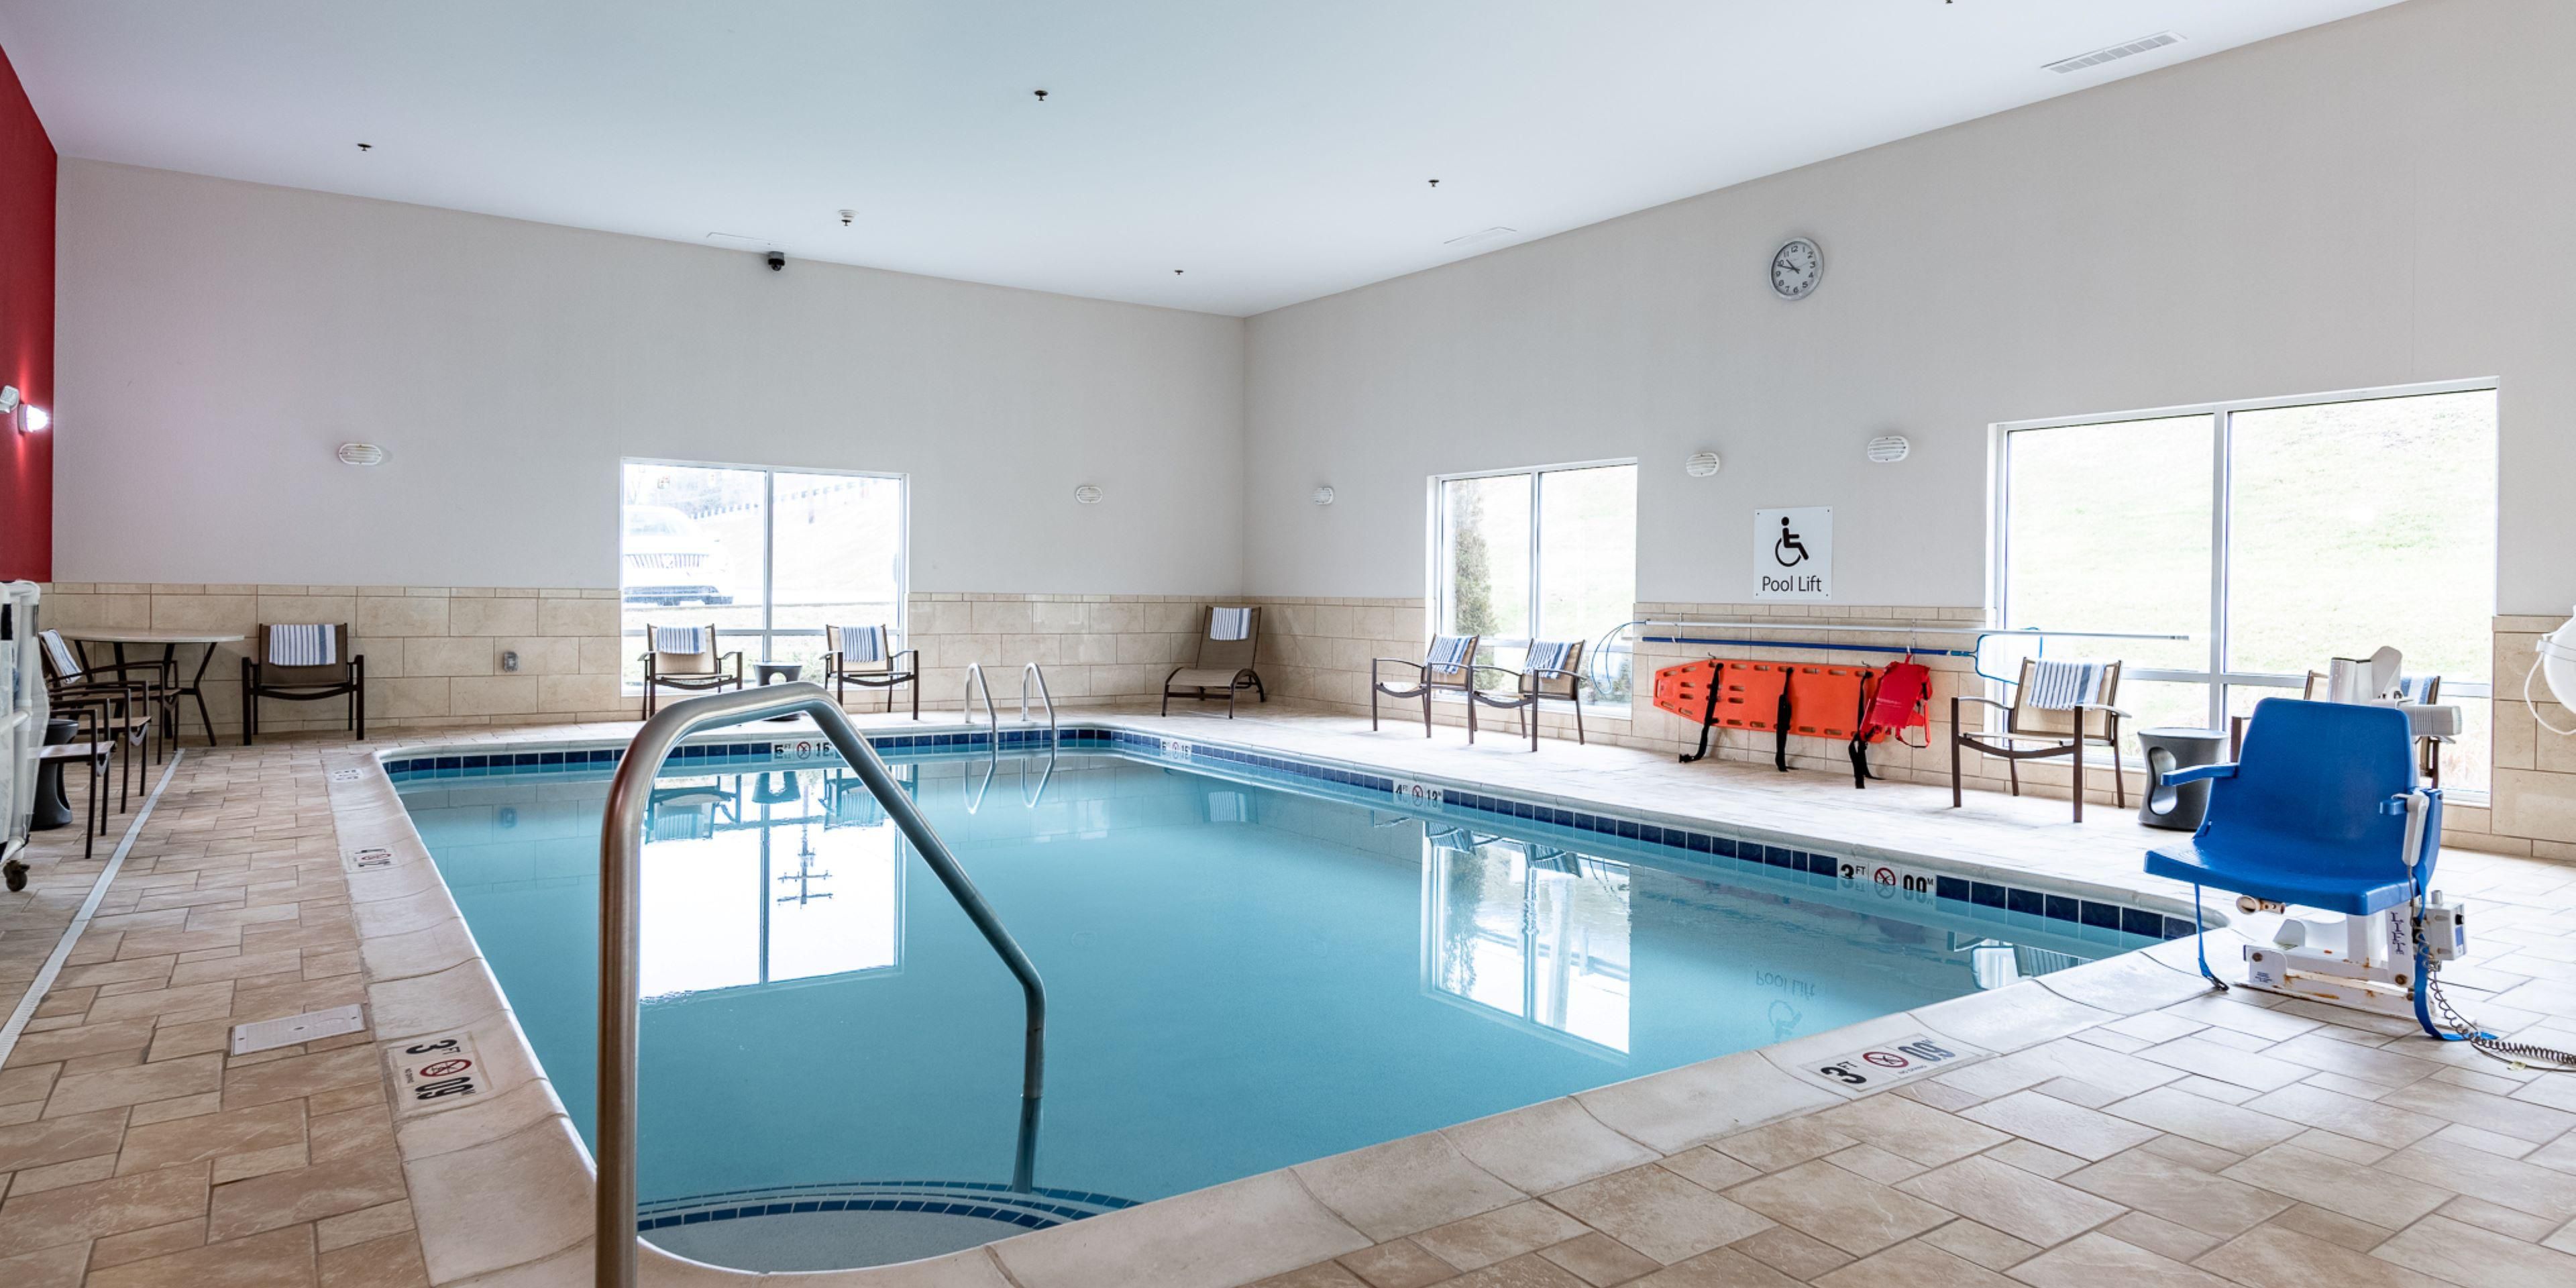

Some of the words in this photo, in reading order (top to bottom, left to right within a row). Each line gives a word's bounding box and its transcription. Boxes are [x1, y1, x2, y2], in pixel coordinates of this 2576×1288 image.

[1762, 575, 1793, 592] Pool
[1799, 575, 1822, 592] Lift
[1841, 864, 1855, 879] 3
[1856, 865, 1866, 875] FT
[2390, 912, 2406, 953] LIFT
[406, 1038, 458, 1054] 3
[1836, 1061, 1858, 1070] FT
[1821, 1065, 1867, 1084] 3
